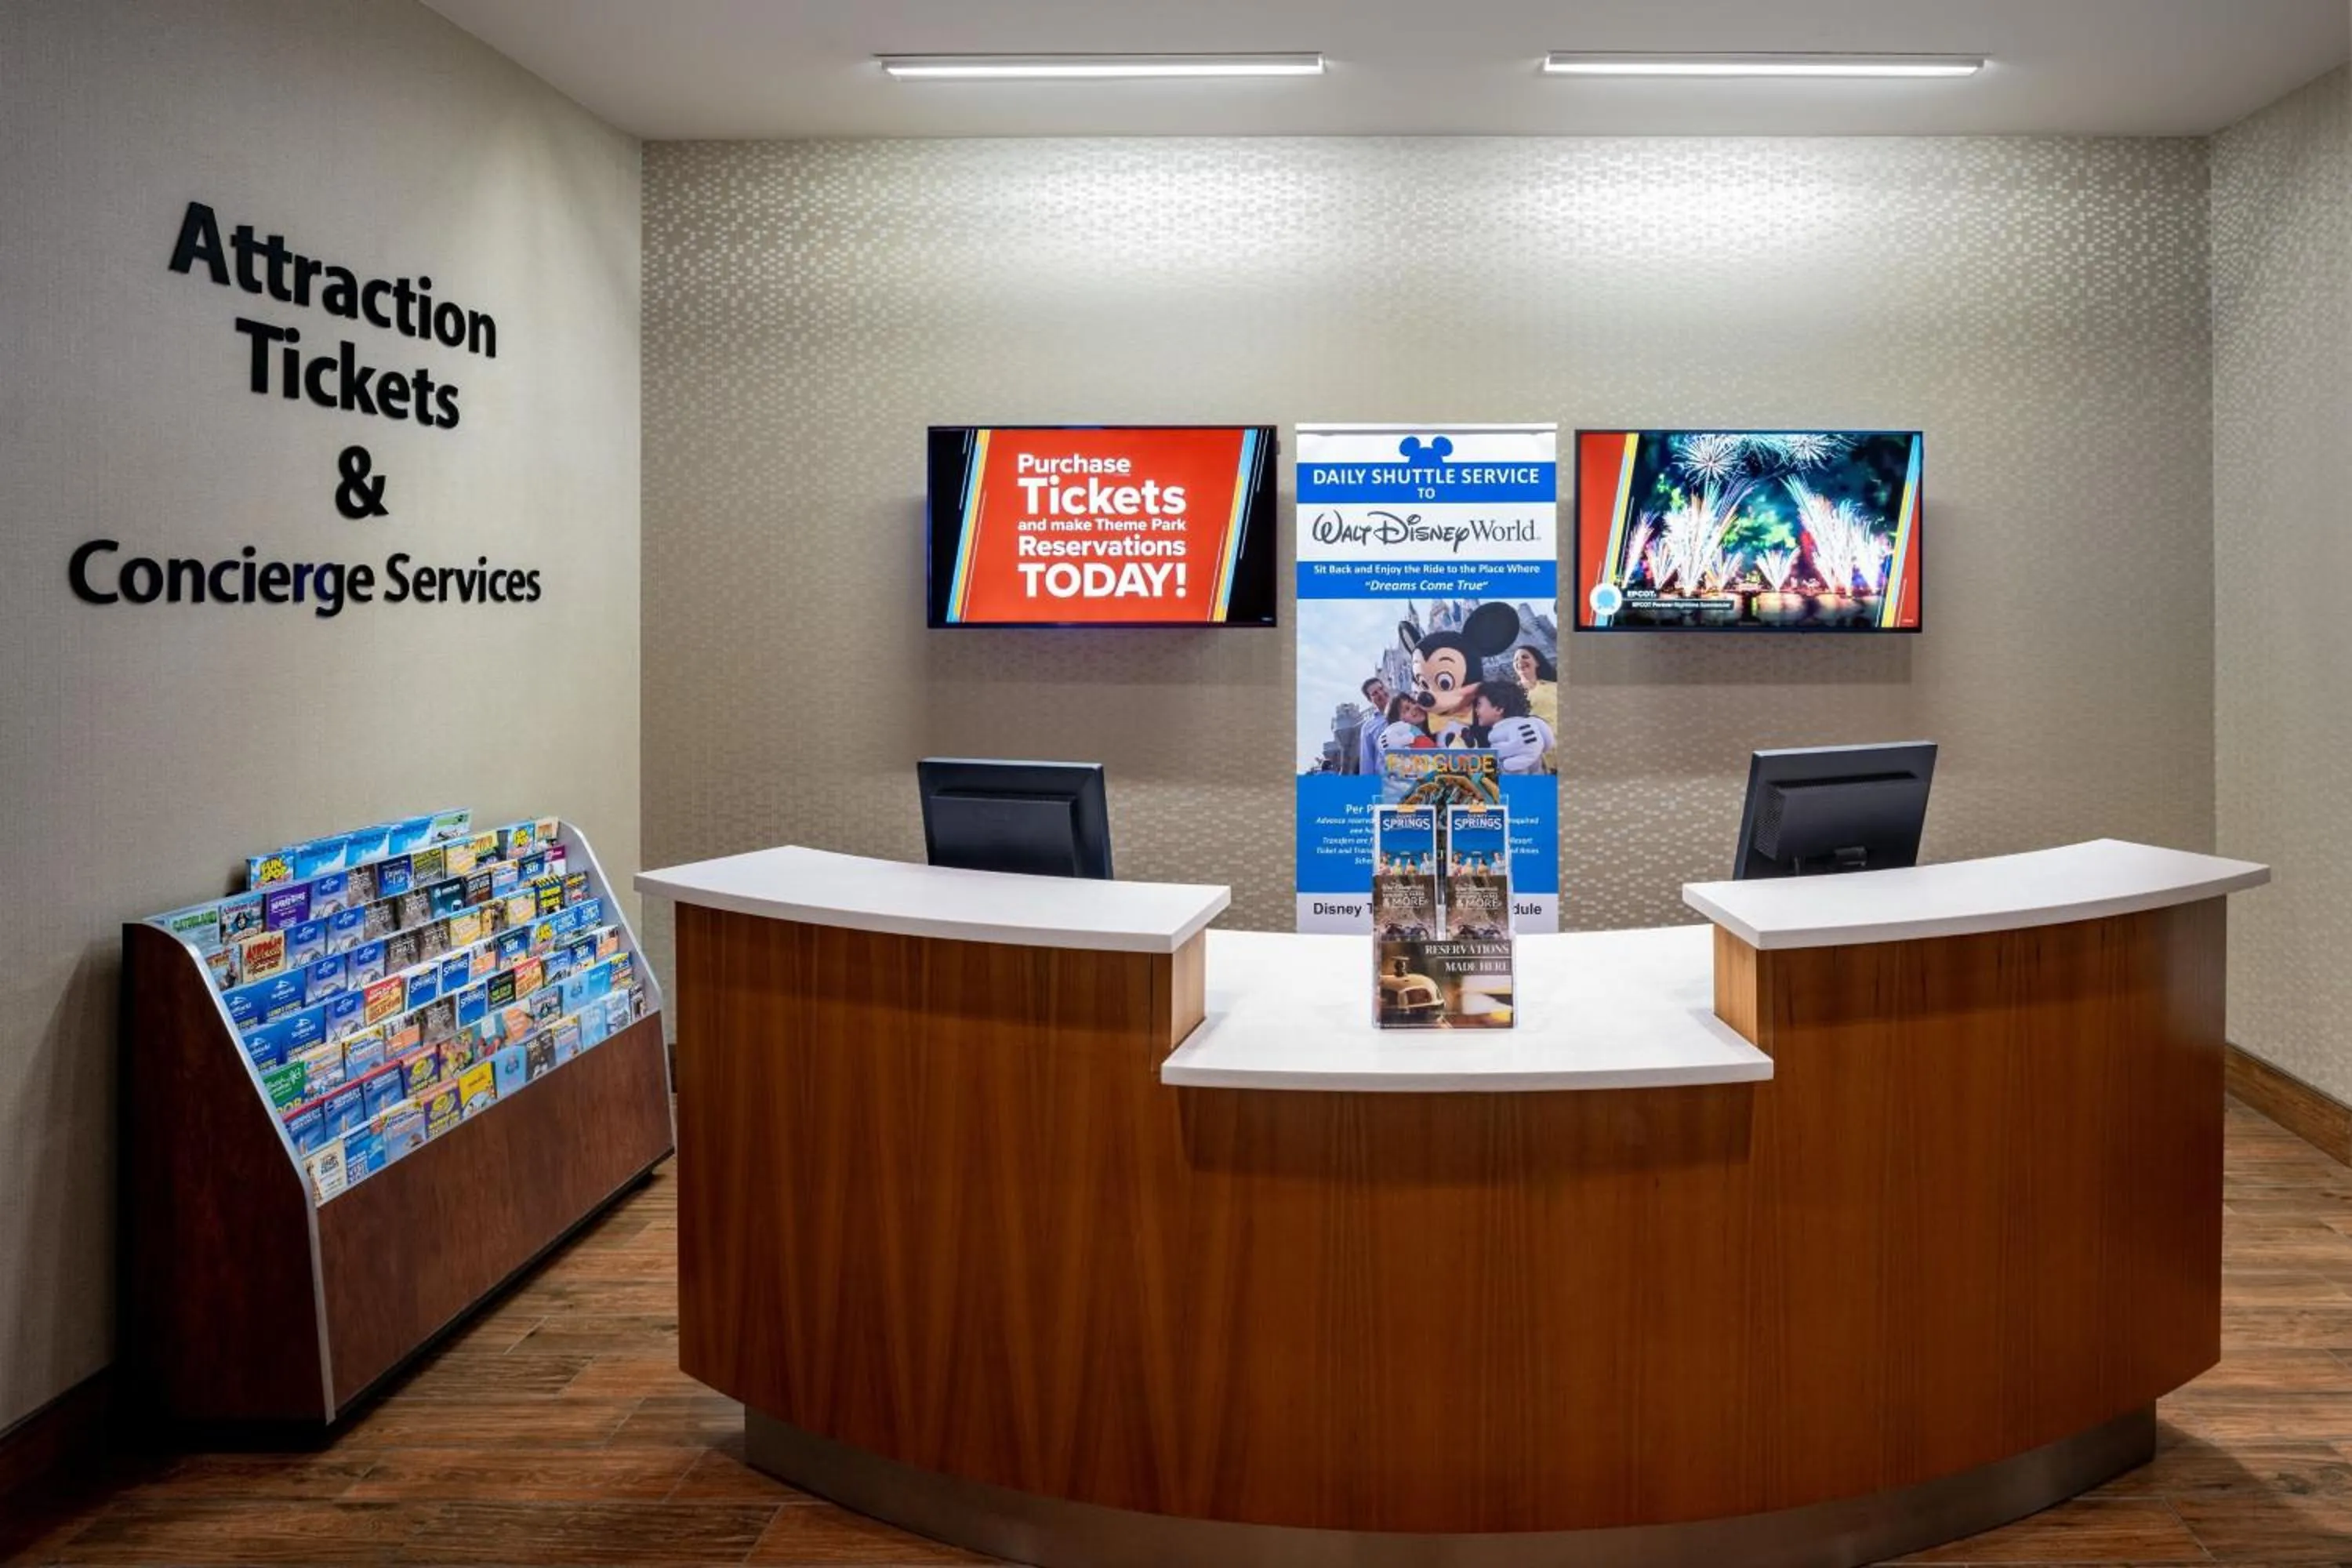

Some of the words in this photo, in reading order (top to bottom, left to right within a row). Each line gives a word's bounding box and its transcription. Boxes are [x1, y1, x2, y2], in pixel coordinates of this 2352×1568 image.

[169, 201, 496, 358] Attraction
[235, 318, 460, 429] Tickets
[1018, 453, 1131, 474] Purchase
[335, 445, 389, 519] &
[1313, 469, 1366, 485] DAILY
[1372, 469, 1456, 485] SHUTTLE
[1461, 468, 1540, 484] SERVICE
[1018, 475, 1186, 515] Tickets
[1417, 488, 1436, 499] TO
[1018, 518, 1047, 532] and
[1051, 518, 1092, 532] make
[1095, 518, 1148, 532] Theme
[1152, 518, 1186, 532] Park
[1018, 535, 1186, 557] Reservations
[1314, 564, 1327, 574] Sit
[1329, 564, 1352, 574] Back
[1354, 564, 1373, 574] and
[1374, 564, 1402, 576] Enjoy
[1404, 564, 1421, 574] the
[1423, 564, 1445, 574] Ride
[1447, 564, 1457, 574] to
[1460, 564, 1476, 574] the
[1479, 564, 1504, 574] Place
[1507, 564, 1541, 574] Where
[68, 539, 375, 618] Concierge
[383, 553, 541, 603] Services
[1018, 562, 1186, 597] TODAY!
[1420, 581, 1453, 591] Come
[1345, 804, 1364, 814] Per
[1382, 818, 1432, 831] SPRINGS
[1454, 818, 1503, 831] SPRINGS
[1313, 902, 1363, 916] Disney
[1512, 902, 1542, 915] dule
[1425, 944, 1509, 955] RESERVATIONS
[1445, 961, 1475, 972] MADE
[1479, 961, 1508, 972] HERE
